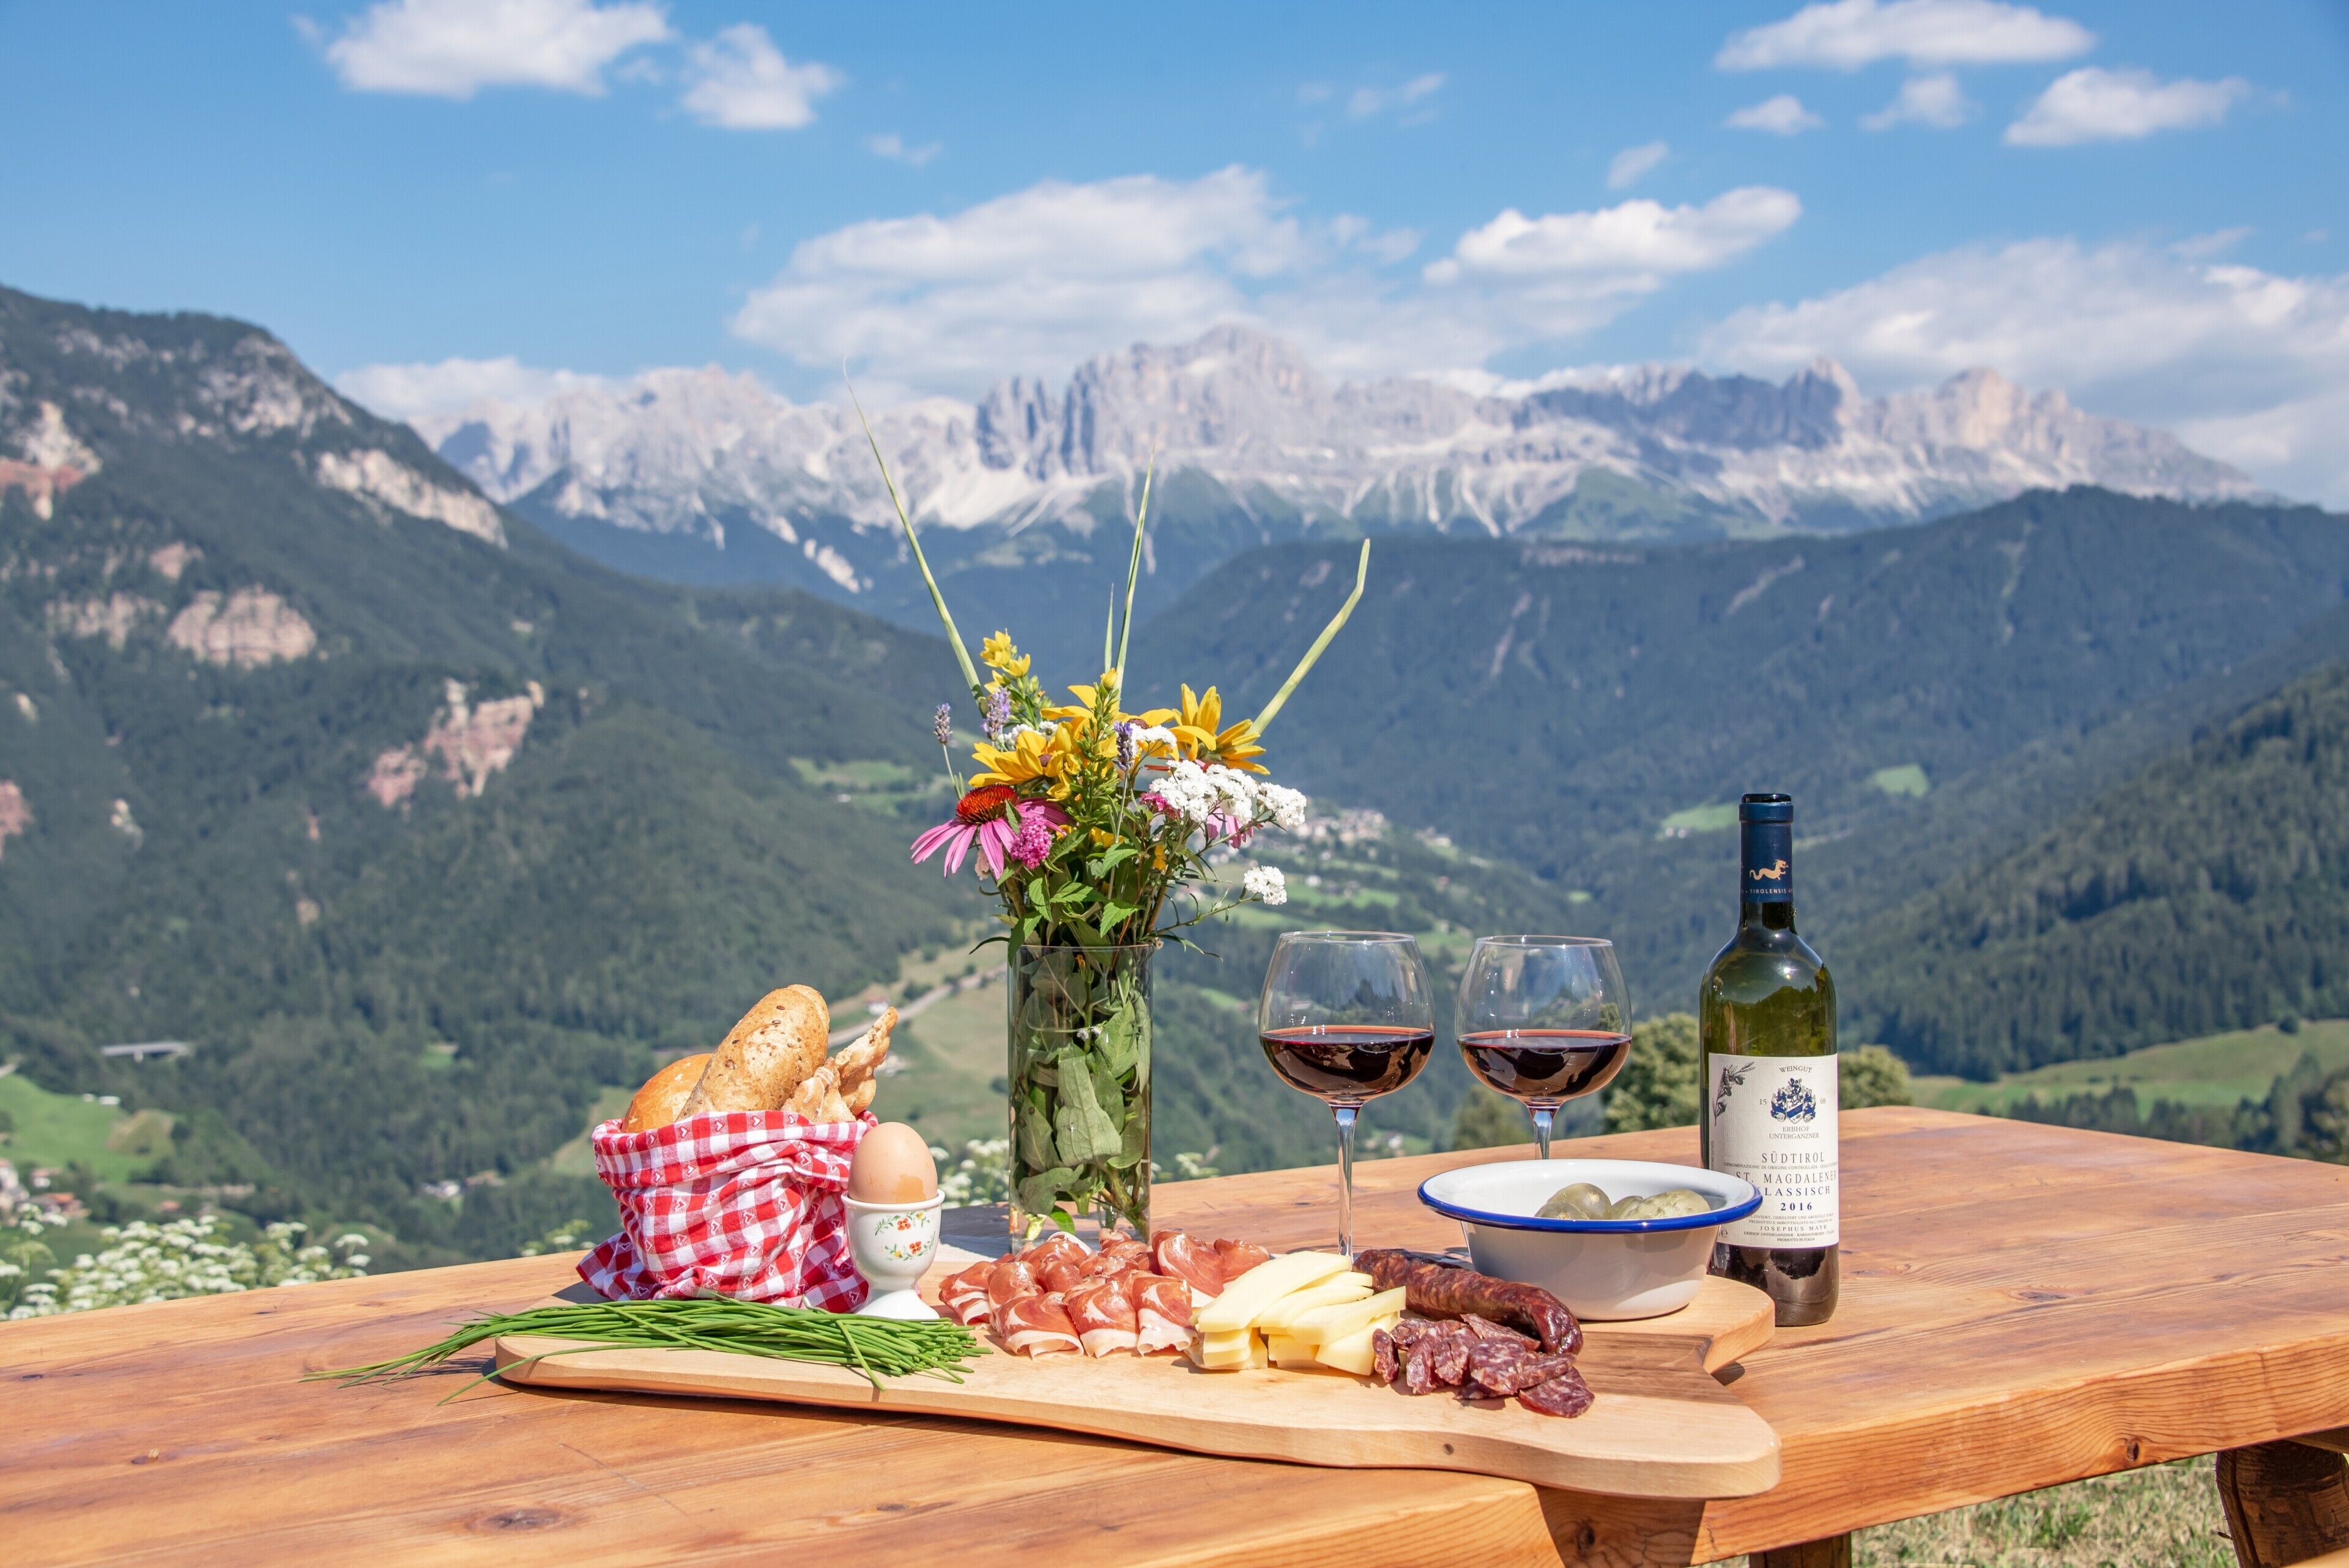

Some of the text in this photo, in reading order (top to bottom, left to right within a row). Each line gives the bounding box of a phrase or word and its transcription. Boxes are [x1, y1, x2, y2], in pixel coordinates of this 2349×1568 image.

[1762, 1151, 1824, 1163] SÜDTIROL
[1764, 1170, 1836, 1184] MAGDALENER
[1759, 1186, 1830, 1196] LASSISCH
[1781, 1202, 1812, 1211] 2016
